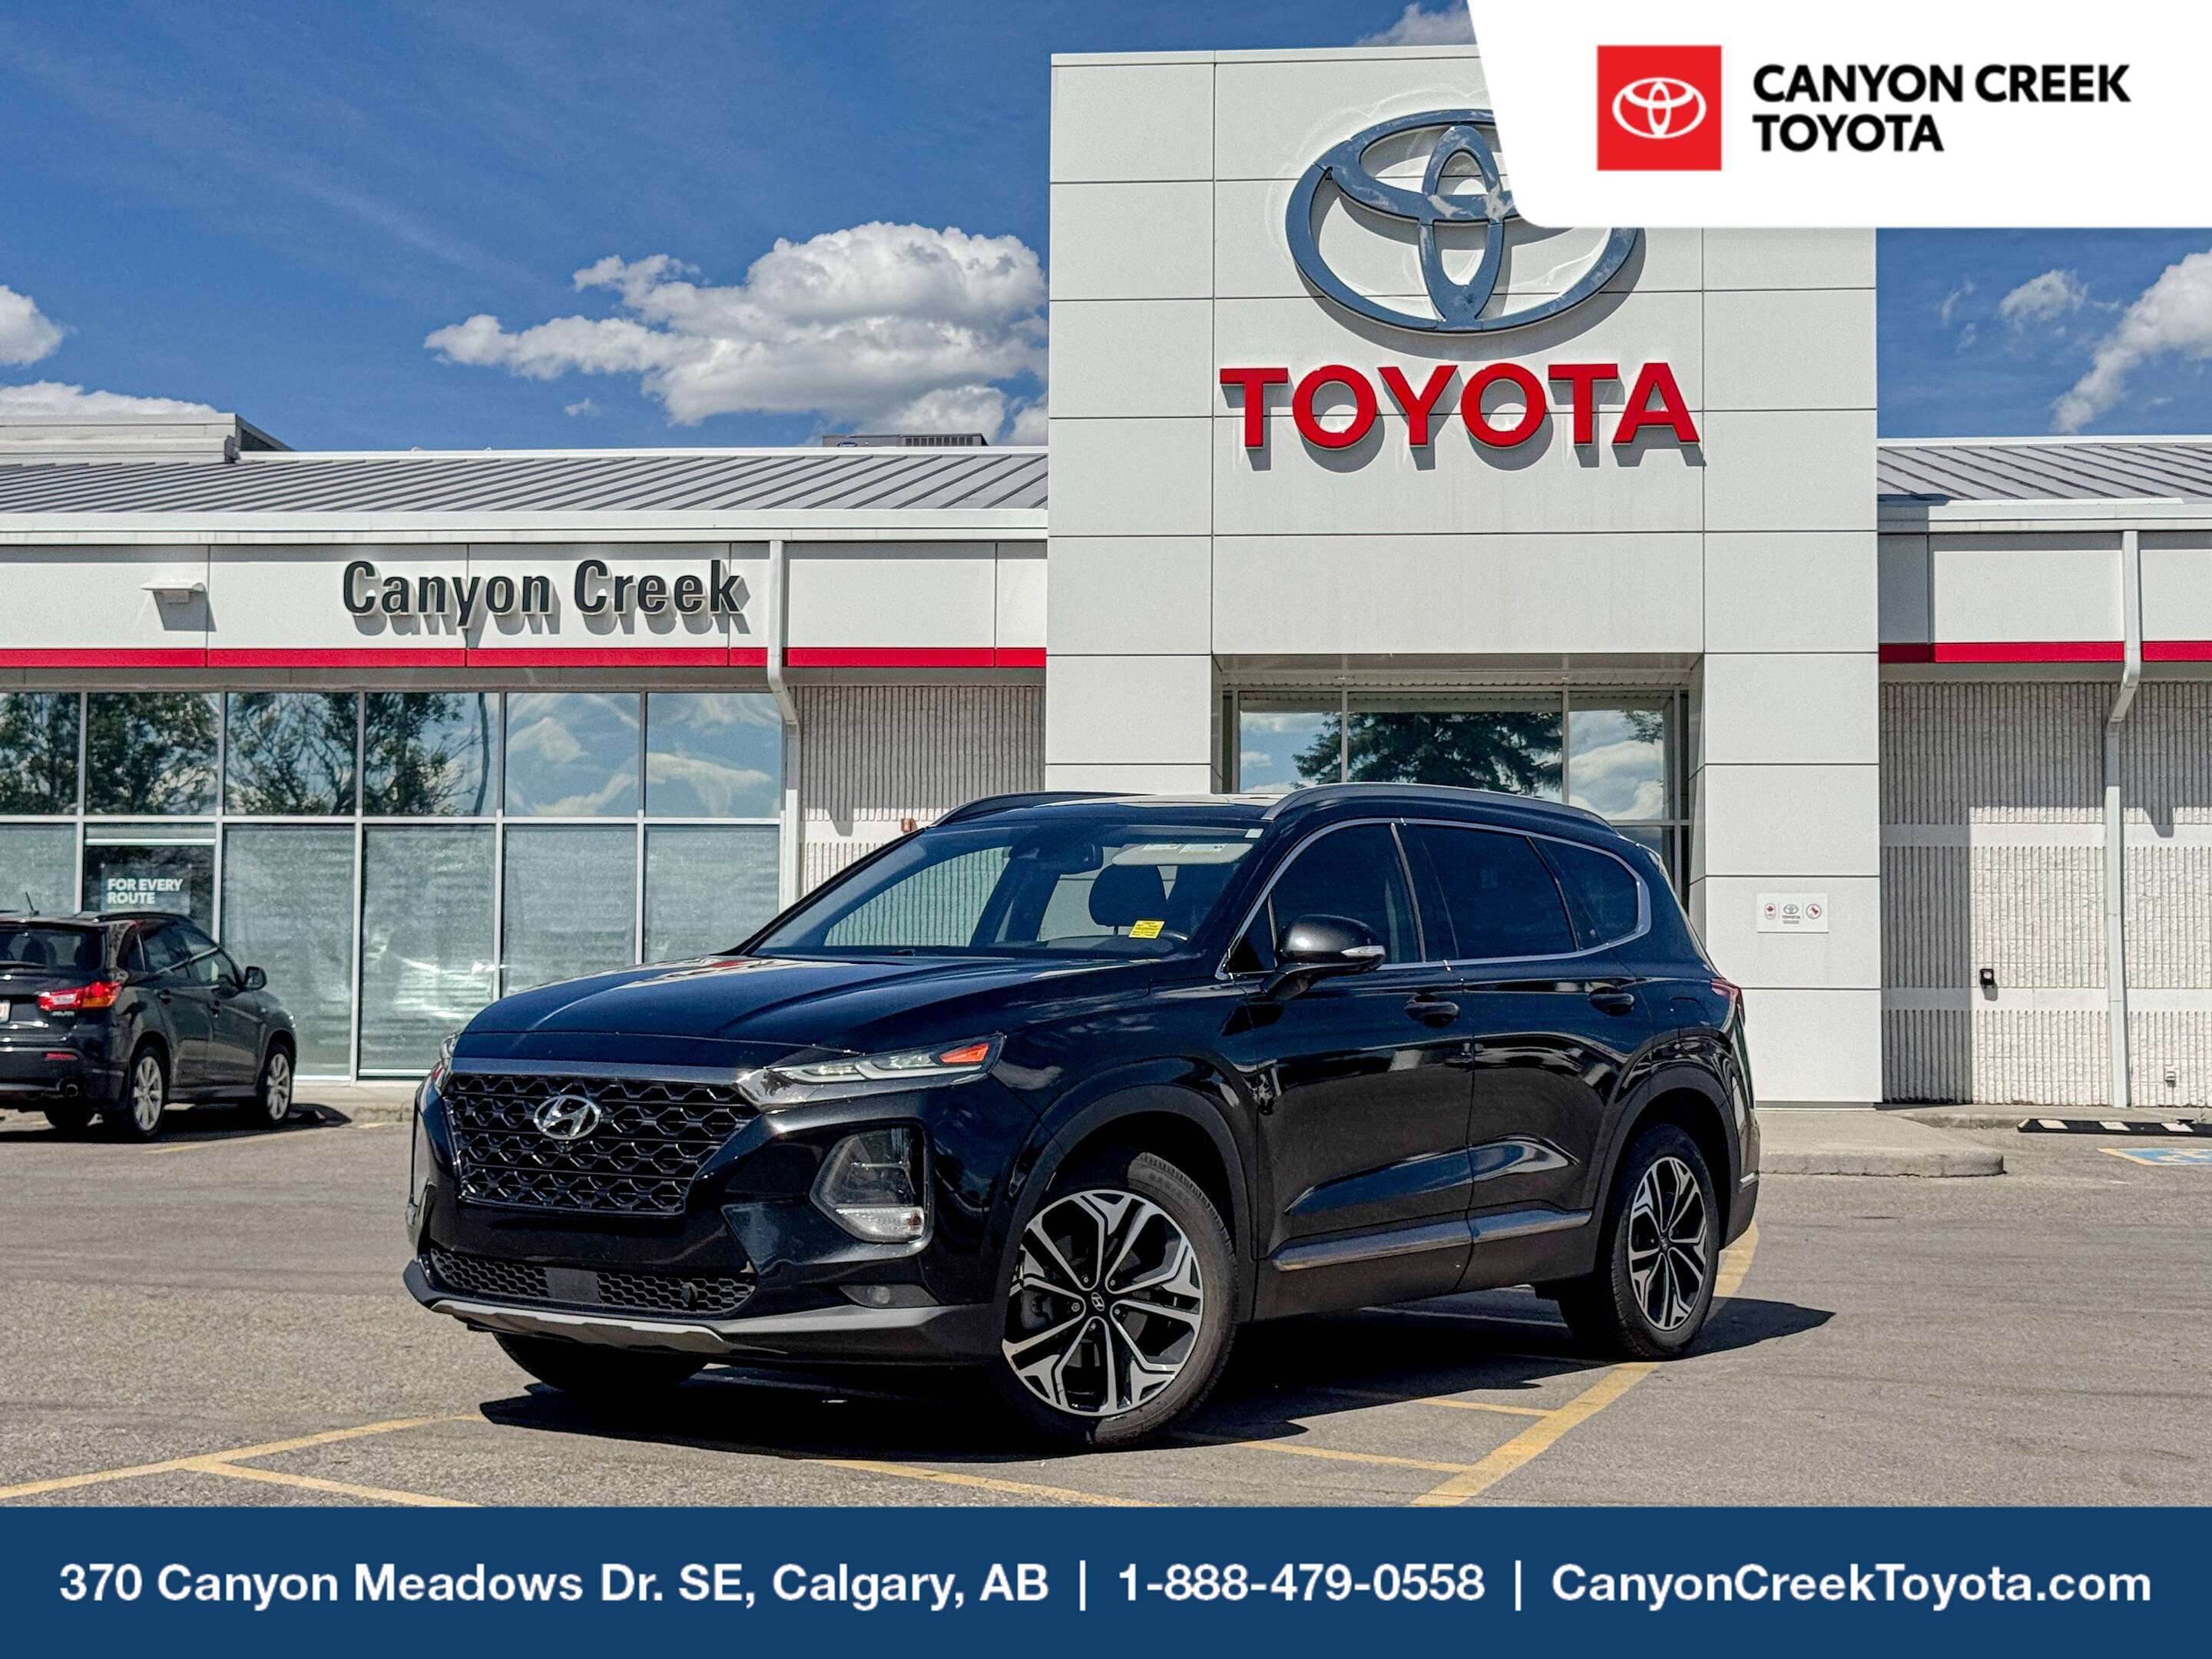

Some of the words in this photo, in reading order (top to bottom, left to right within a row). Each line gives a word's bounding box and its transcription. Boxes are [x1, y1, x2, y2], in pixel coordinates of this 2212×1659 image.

[1220, 363, 1700, 448] TOYOTA
[343, 560, 552, 628] Canyon
[575, 559, 744, 614] Creek
[108, 878, 137, 891] FOR
[139, 878, 184, 892] EVERY
[108, 892, 156, 905] ROUTE
